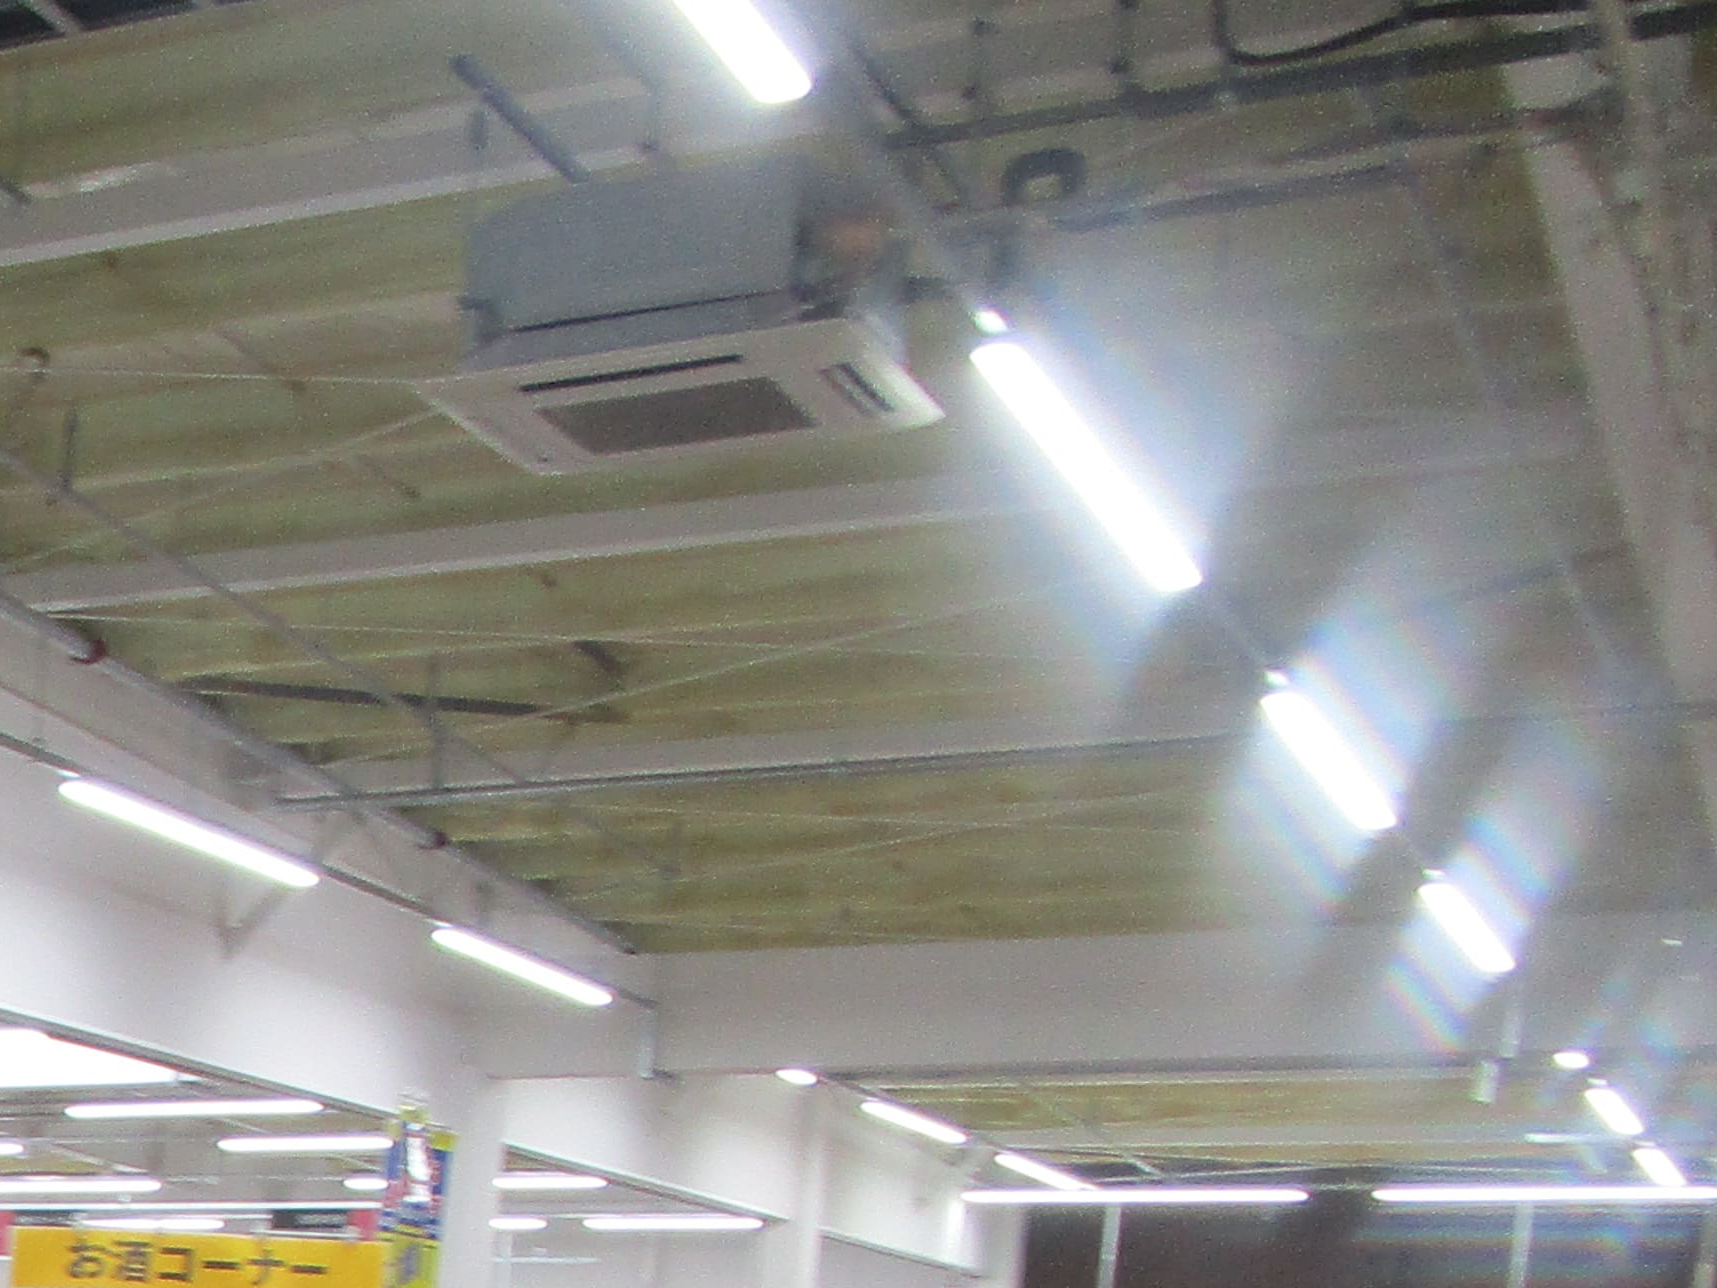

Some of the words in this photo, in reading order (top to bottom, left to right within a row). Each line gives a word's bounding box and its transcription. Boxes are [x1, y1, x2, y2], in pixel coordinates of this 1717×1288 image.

[66, 1237, 331, 1288] お酒コーナー
